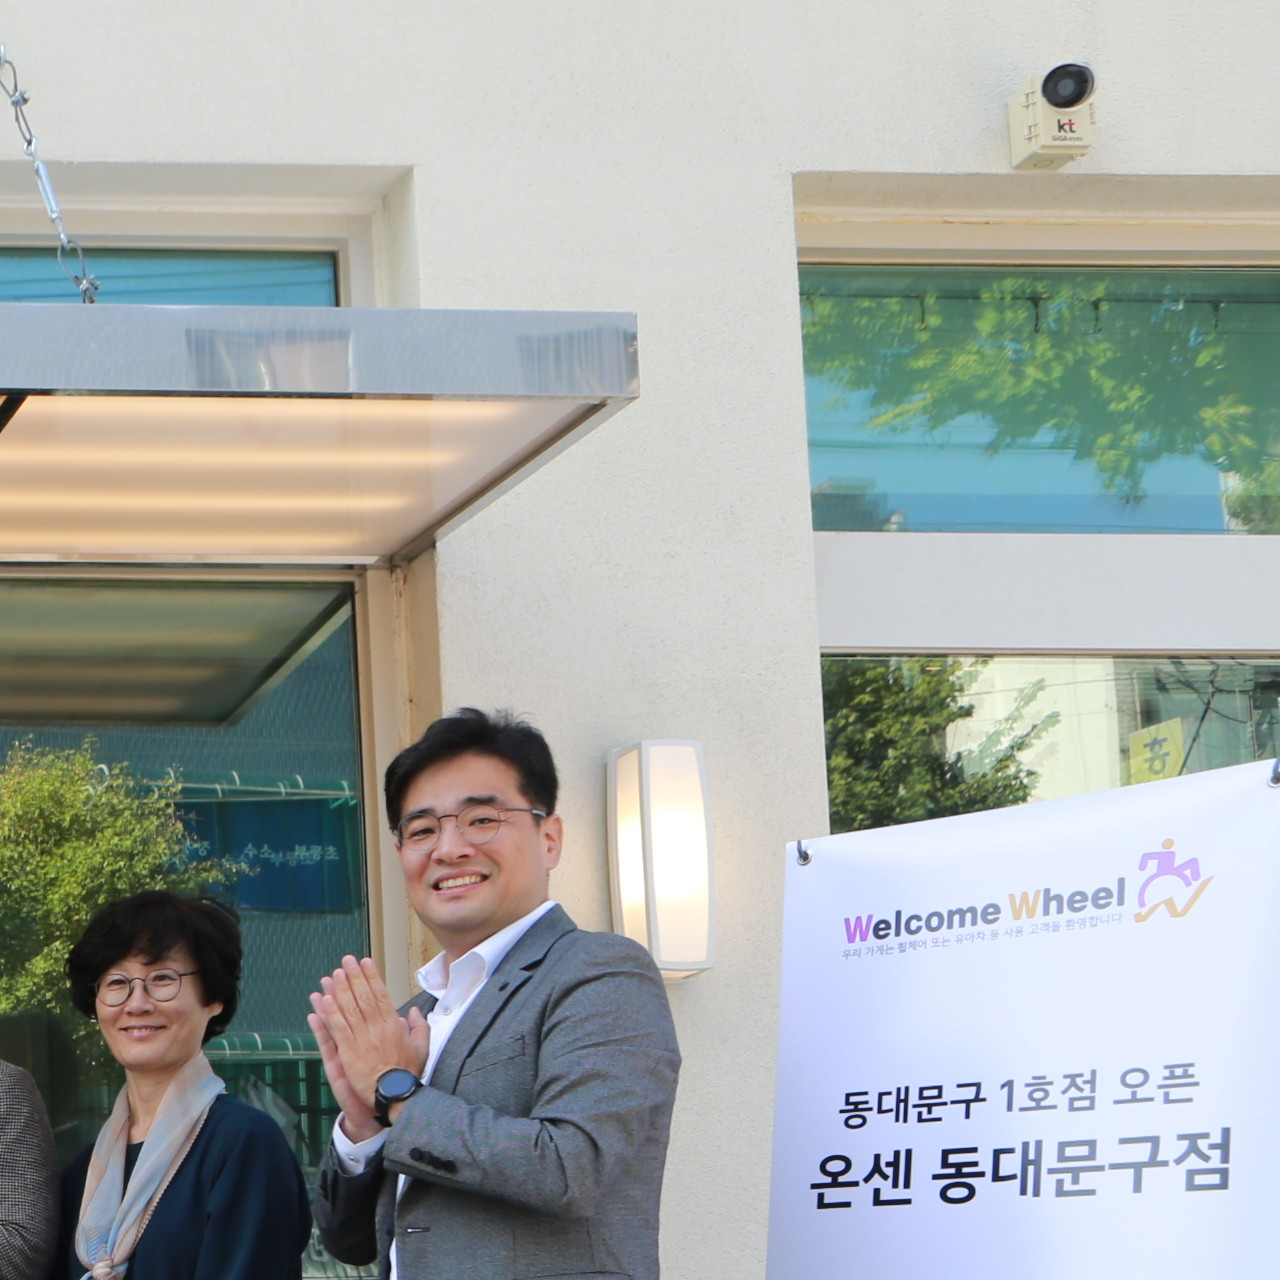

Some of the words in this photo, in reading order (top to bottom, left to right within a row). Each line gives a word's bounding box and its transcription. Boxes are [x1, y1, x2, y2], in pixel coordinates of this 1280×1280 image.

[1057, 118, 1076, 133] kt
[841, 948, 861, 960] 우리
[864, 944, 895, 957] 가게는
[897, 938, 928, 953] 휠체어
[930, 936, 952, 949] 또는
[954, 931, 987, 946] 유아차
[989, 929, 1000, 941] 등
[1003, 925, 1026, 938] 사용
[1028, 921, 1062, 936] 고객을
[1065, 912, 1124, 931] 환영합니다
[844, 901, 1002, 945] Welcome
[1007, 877, 1126, 922] Wheel
[838, 1082, 987, 1130] 동대문구
[999, 1069, 1098, 1114] 1호점
[1112, 1062, 1201, 1107] 오픈
[809, 1147, 913, 1210] 온센
[931, 1126, 1233, 1205] 동대문구점
